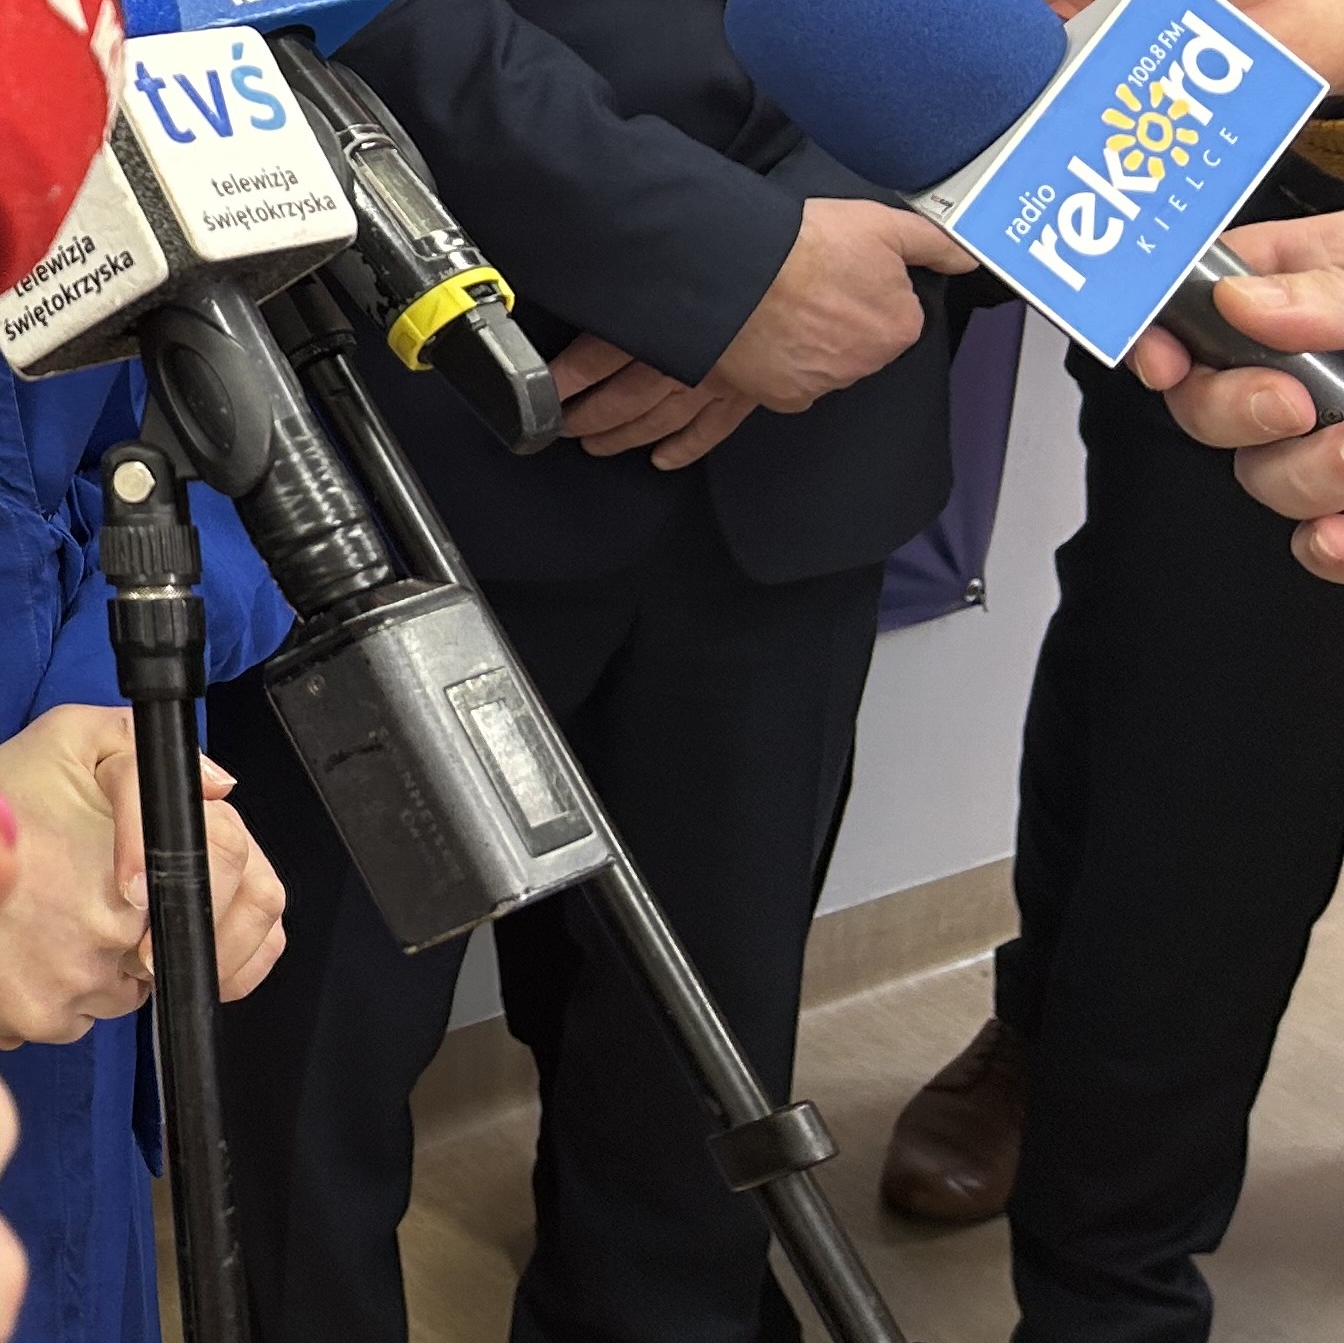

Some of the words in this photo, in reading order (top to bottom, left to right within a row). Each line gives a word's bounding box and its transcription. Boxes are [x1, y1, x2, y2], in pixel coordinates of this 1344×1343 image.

[134, 42, 286, 143] tvś
[1127, 44, 1166, 87] 100.8
[1158, 20, 1185, 50] FM
[211, 166, 299, 197] telewizja
[1028, 9, 1254, 292] rekord
[203, 192, 337, 232] świętokrzyska
[1004, 184, 1056, 243] radio
[1136, 127, 1238, 254] KIELCE
[3, 250, 135, 342] świętokrzyska
